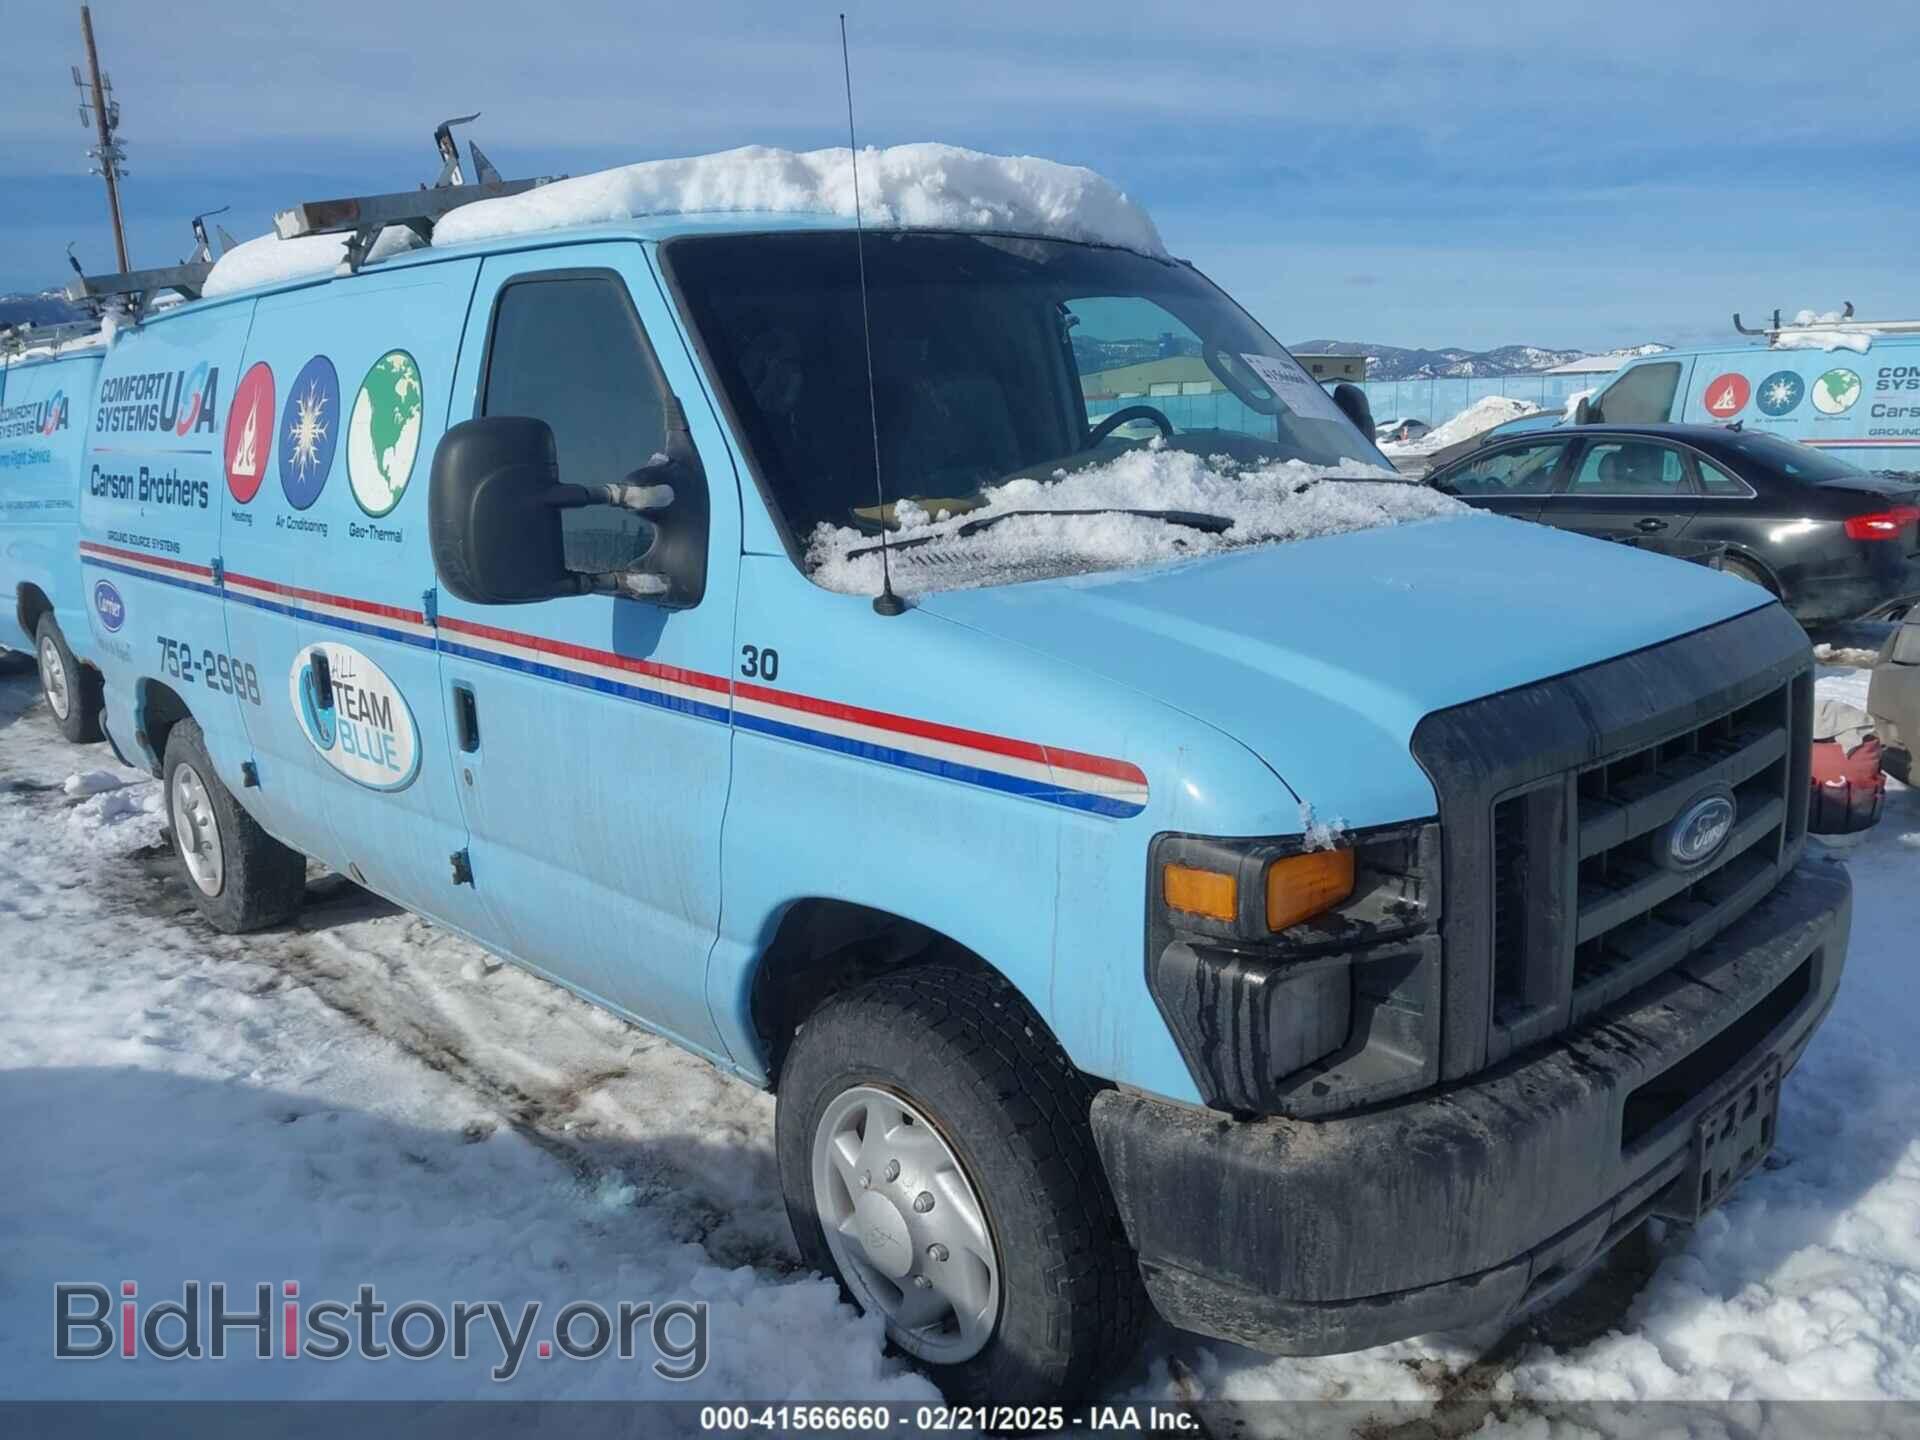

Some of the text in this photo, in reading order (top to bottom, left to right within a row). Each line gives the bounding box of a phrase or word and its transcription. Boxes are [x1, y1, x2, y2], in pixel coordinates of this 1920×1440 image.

[100, 372, 165, 403] COMFORT
[0, 403, 38, 422] OMFORT
[96, 404, 159, 432] SYSTEMS
[91, 463, 209, 509] Carson Brothers
[276, 514, 328, 537] Air Conditioning
[349, 522, 403, 543] Geo-Thermal
[329, 651, 357, 679] ALL
[740, 644, 779, 682] 30
[331, 679, 394, 733] TEAM
[338, 718, 401, 772] BLUE
